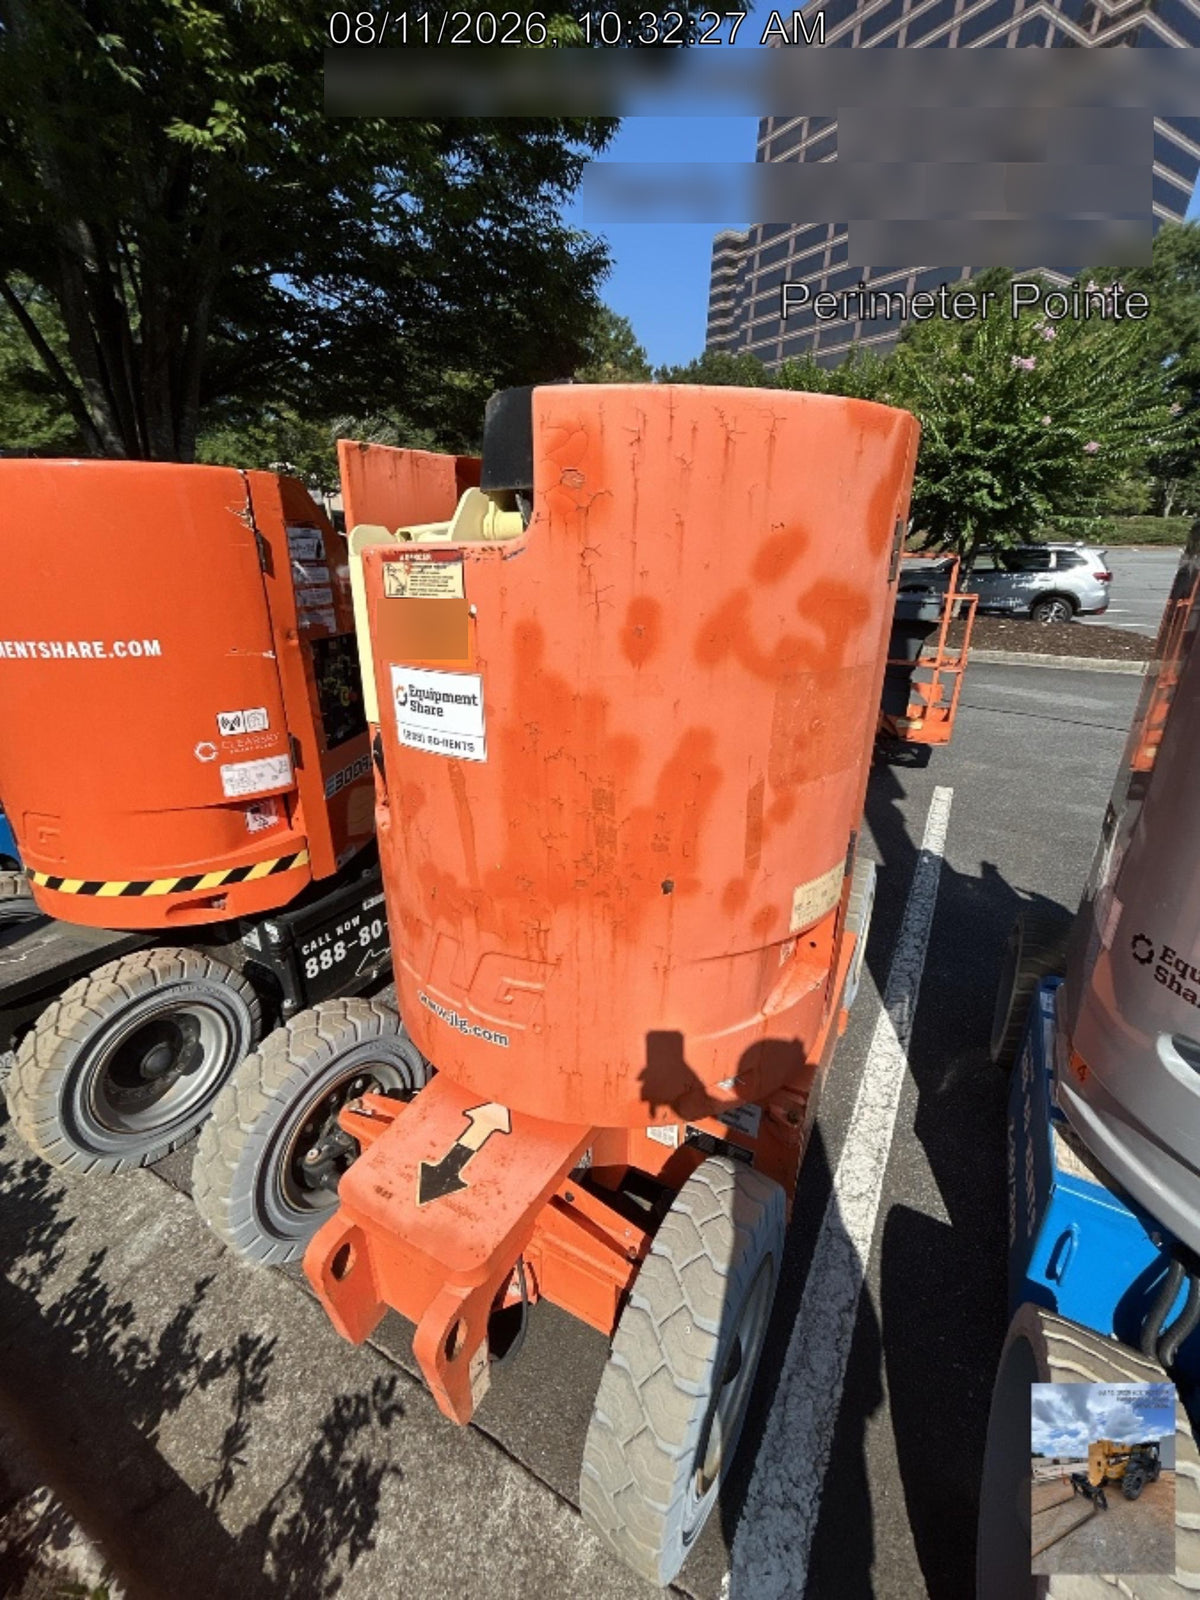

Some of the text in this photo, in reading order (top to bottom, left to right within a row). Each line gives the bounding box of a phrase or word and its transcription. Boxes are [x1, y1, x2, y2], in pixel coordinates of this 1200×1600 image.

[0, 640, 162, 659] ENTSHARE.COM
[408, 684, 478, 706] Equipment
[410, 700, 444, 717] Share
[302, 915, 360, 955] CALL NOW
[1154, 964, 1200, 1009] Sha
